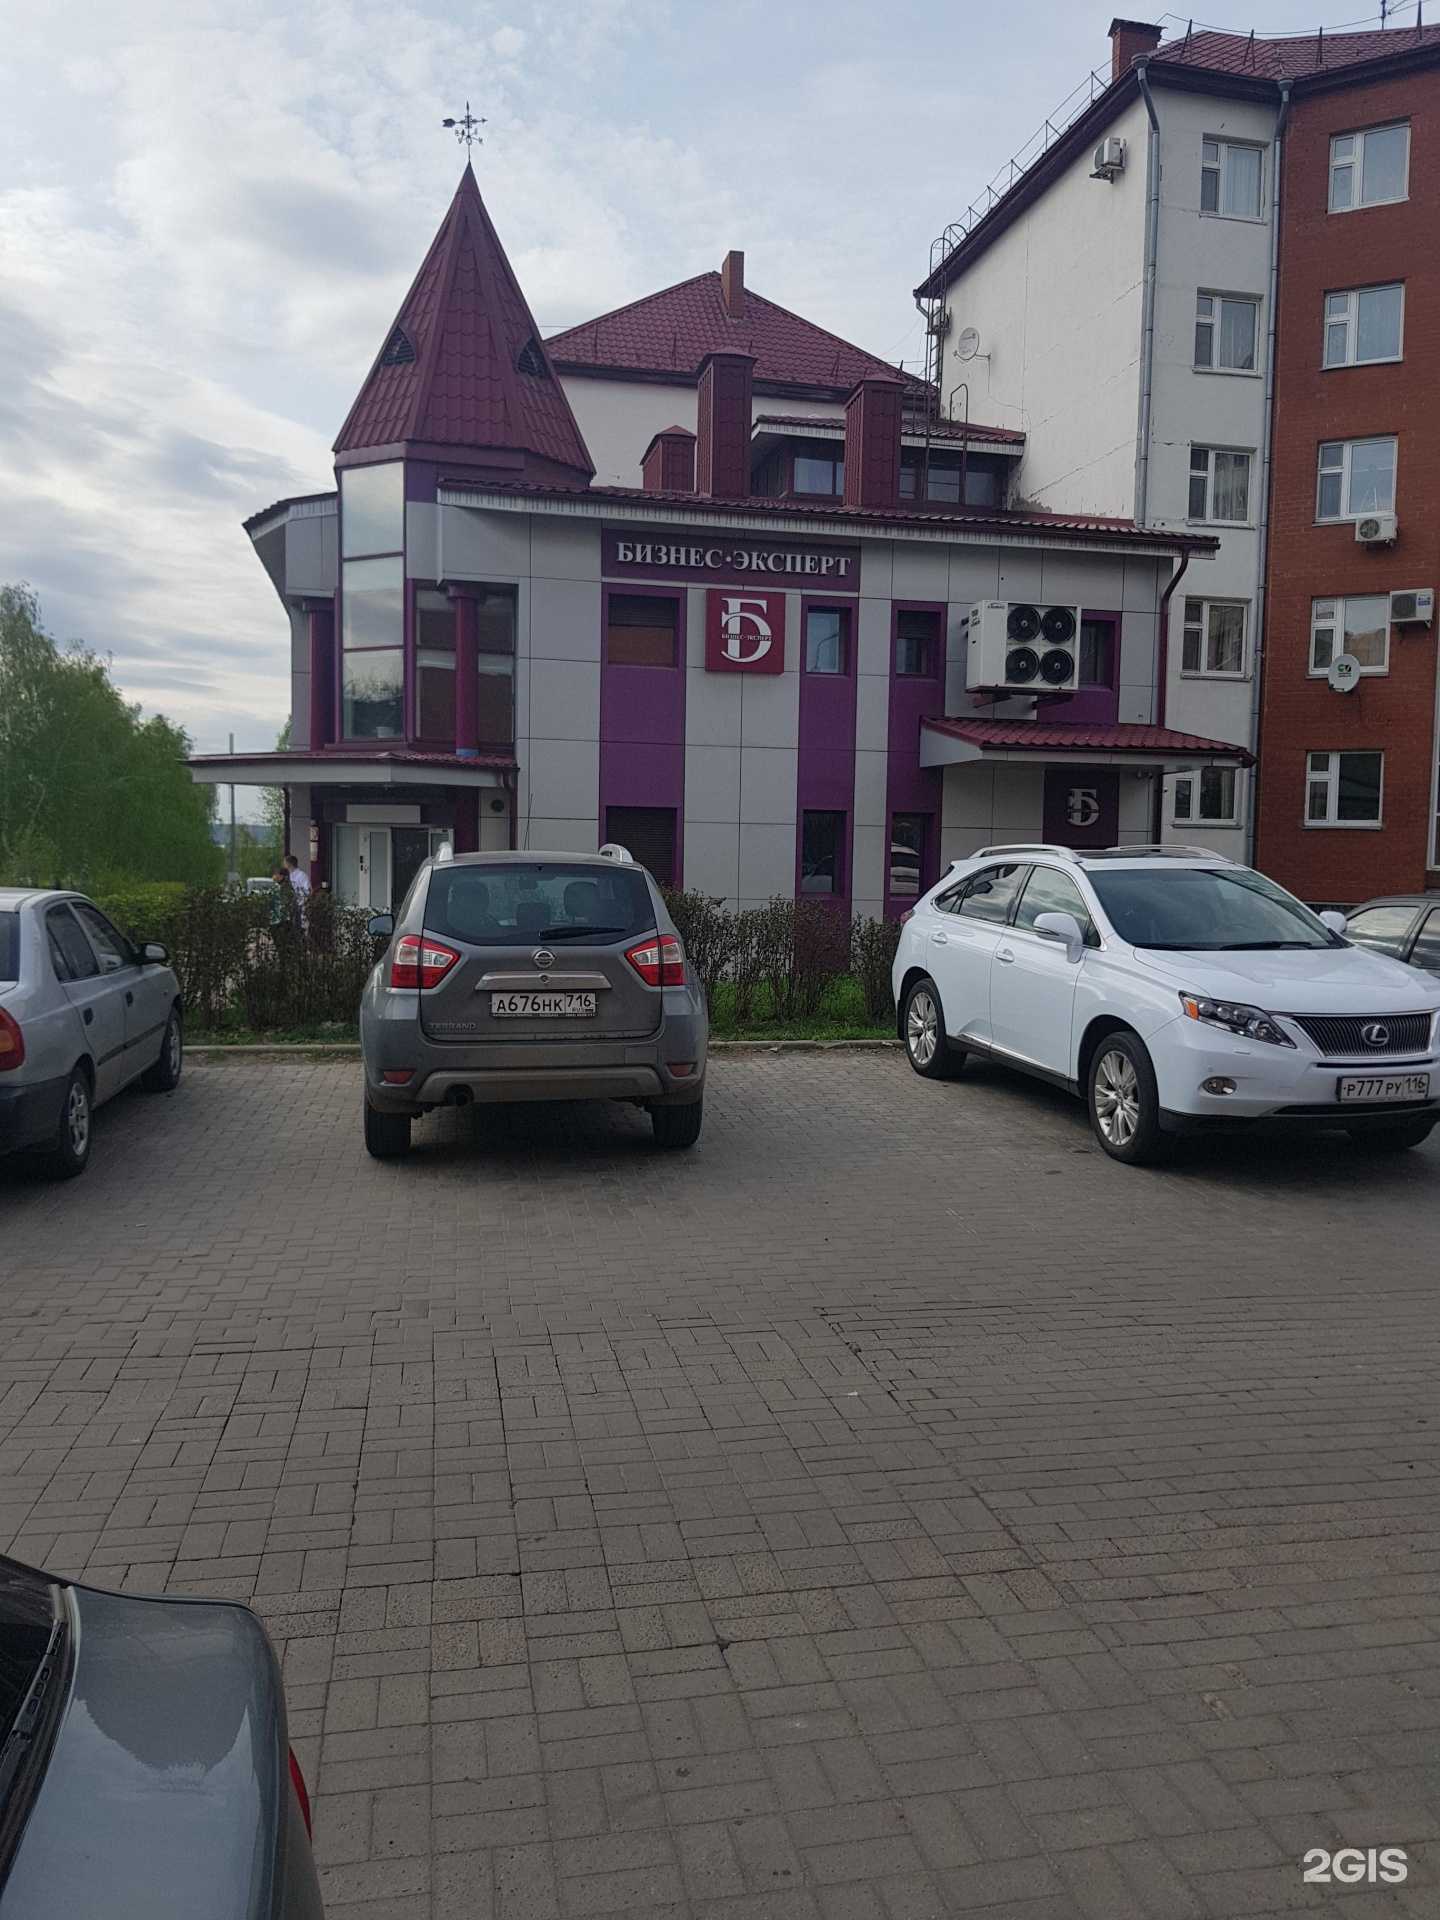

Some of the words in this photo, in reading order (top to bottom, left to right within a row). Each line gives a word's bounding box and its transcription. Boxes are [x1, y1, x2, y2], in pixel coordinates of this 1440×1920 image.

[566, 993, 592, 1007] 716
[1346, 1079, 1402, 1097] Р777РУ
[1405, 1077, 1426, 1089] 116
